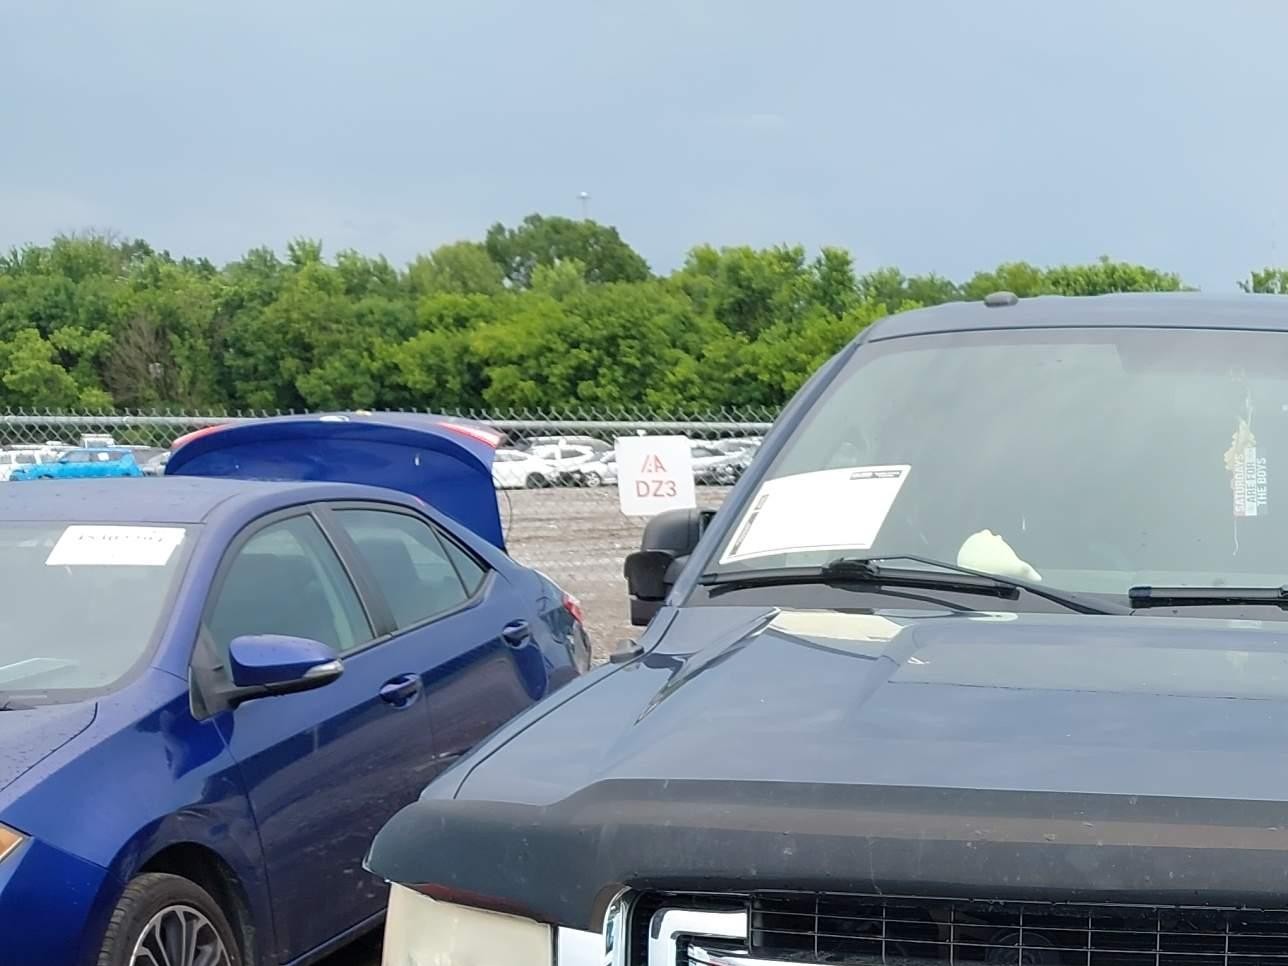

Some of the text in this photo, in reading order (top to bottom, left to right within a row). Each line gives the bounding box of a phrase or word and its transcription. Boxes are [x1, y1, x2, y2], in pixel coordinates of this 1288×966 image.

[635, 479, 678, 498] DZ3
[1234, 453, 1245, 512] SATURDAYS
[1246, 462, 1257, 503] ARE FOR
[1256, 457, 1268, 506] THE BOYS
